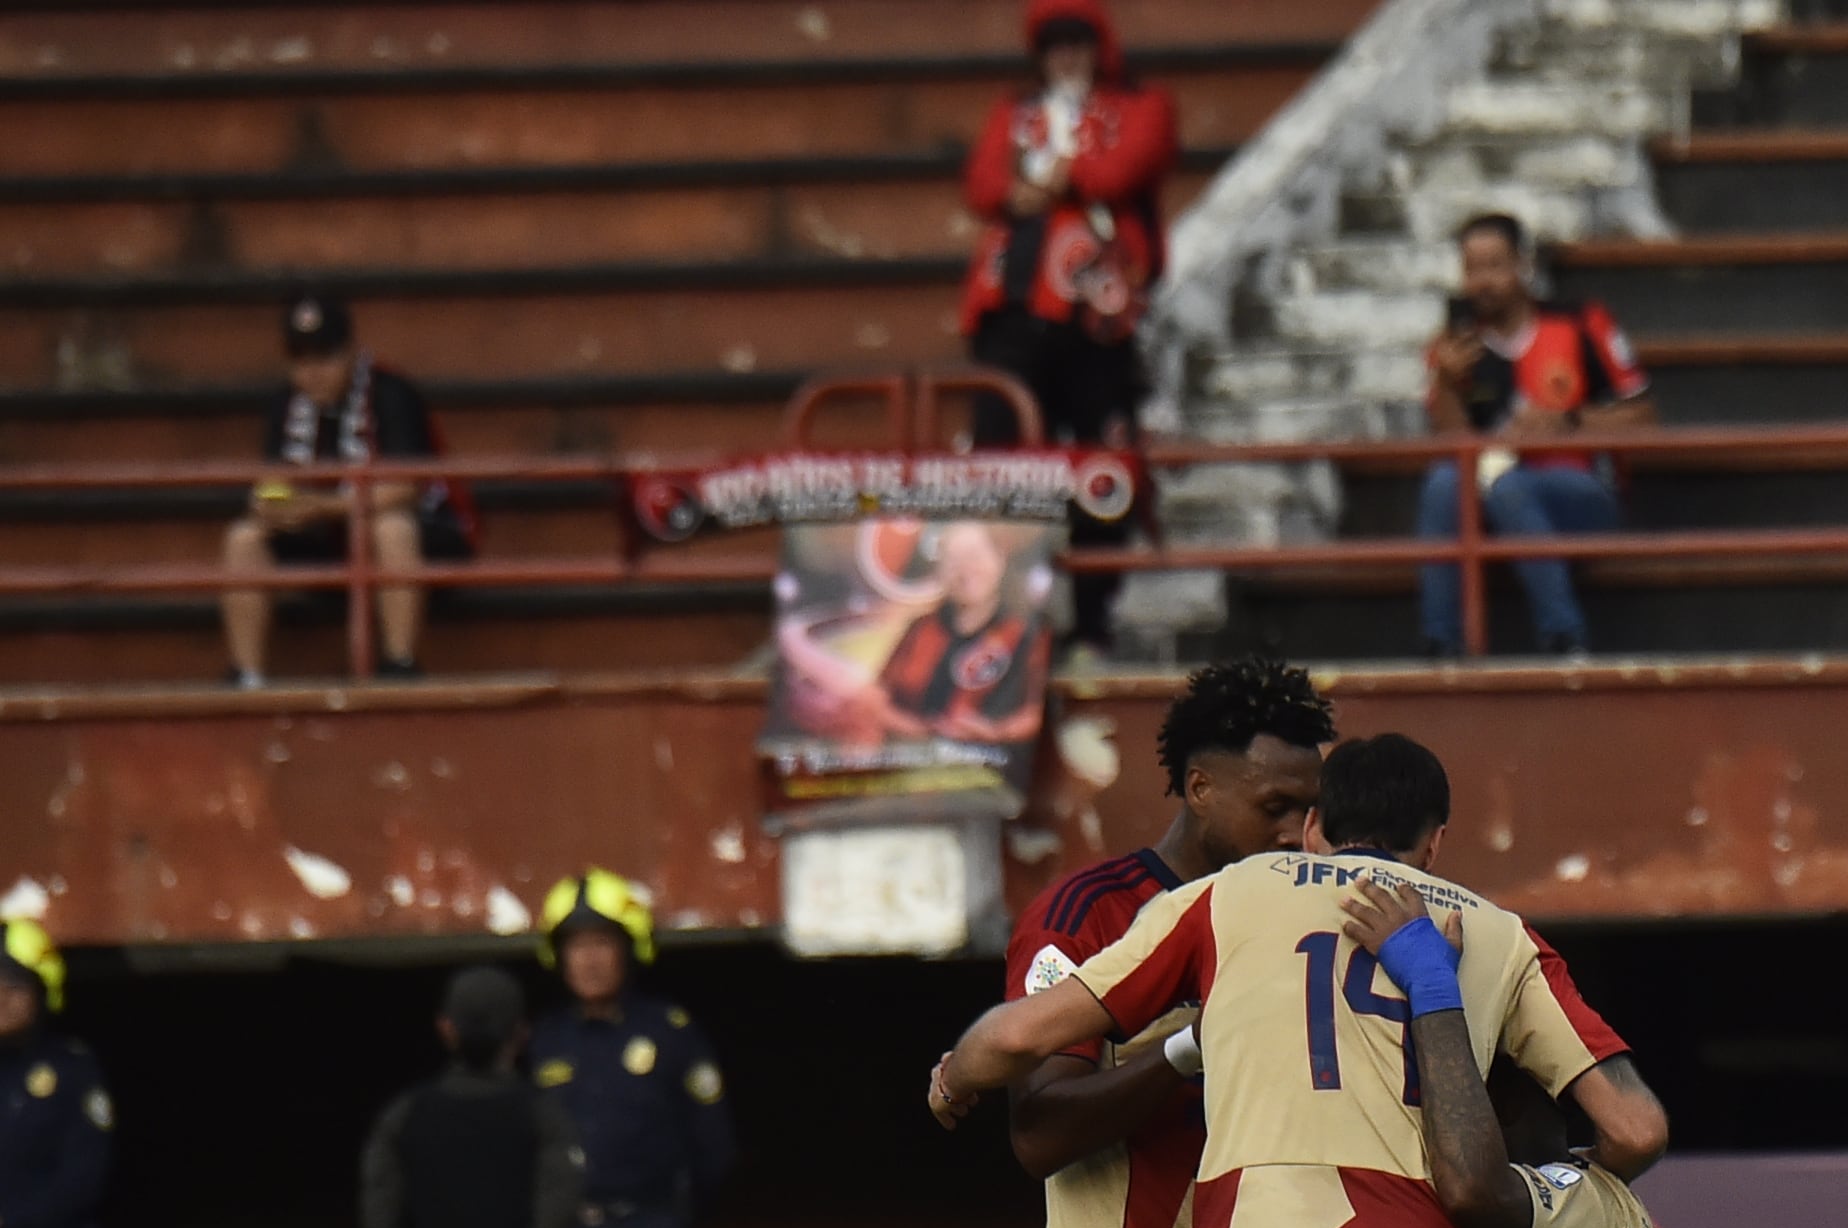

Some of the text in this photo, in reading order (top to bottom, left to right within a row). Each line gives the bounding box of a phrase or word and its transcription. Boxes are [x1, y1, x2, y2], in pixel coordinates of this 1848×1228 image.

[863, 456, 903, 489] DE
[1294, 862, 1365, 887] JFK
[1371, 875, 1462, 911] Finciera
